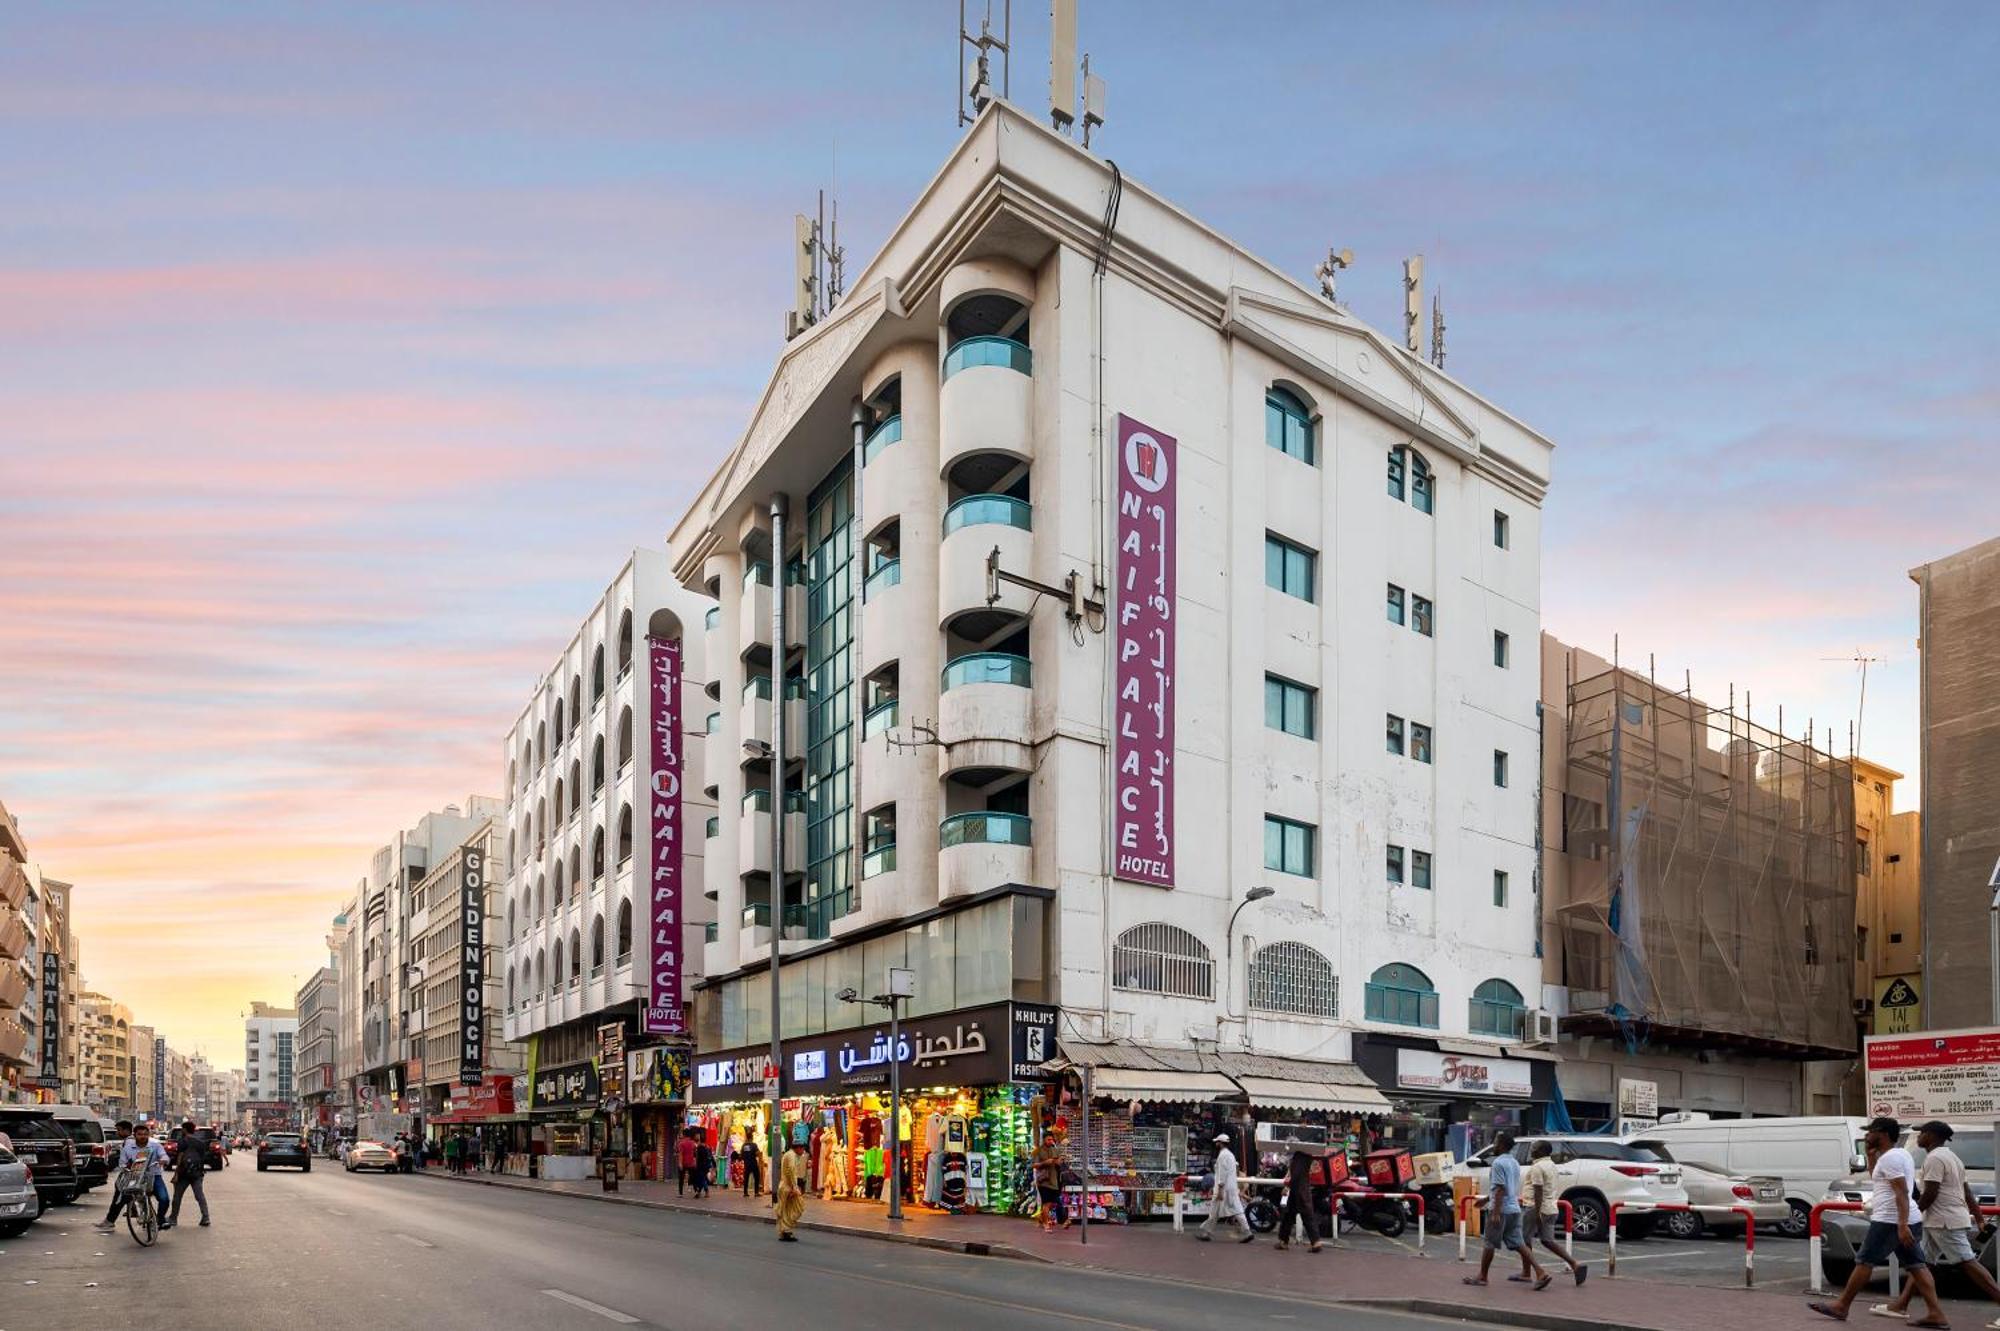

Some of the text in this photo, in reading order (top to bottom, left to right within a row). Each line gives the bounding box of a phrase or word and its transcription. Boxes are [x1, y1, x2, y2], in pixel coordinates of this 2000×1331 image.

[1120, 854, 1169, 879] HOTEL
[45, 955, 56, 1075] ANTALIA
[649, 1008, 682, 1020] HOTEL
[1015, 1010, 1054, 1024] KHILJI'S
[839, 1022, 986, 1073] خلجيز فاشن
[1935, 1039, 1945, 1049] P
[462, 1073, 482, 1082] HOTEL
